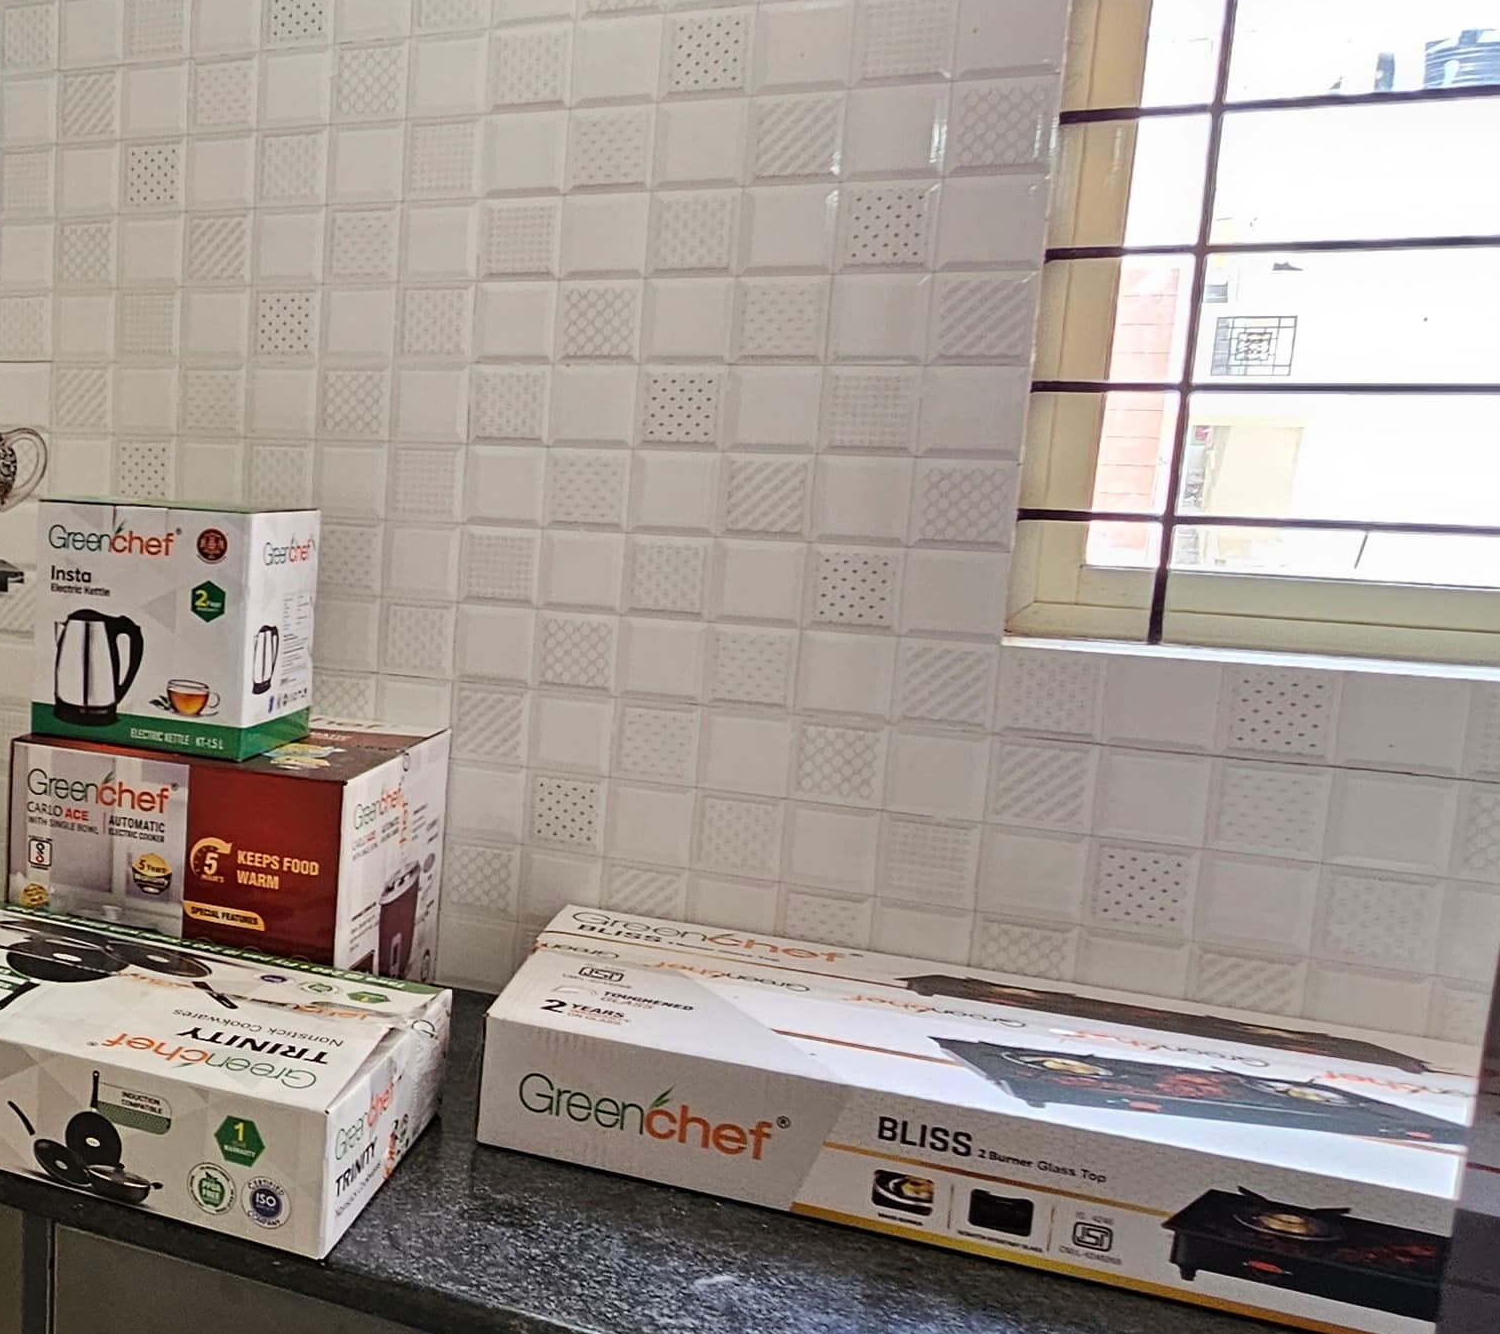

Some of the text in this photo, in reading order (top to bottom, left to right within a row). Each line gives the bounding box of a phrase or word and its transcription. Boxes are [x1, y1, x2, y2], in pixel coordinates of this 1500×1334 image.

[48, 523, 175, 557] Greenchef
[51, 565, 92, 584] Insta
[50, 583, 111, 597] Electric Kettle
[195, 589, 209, 607] 2
[130, 727, 163, 743] ELECTRIC
[164, 731, 191, 746] KETTLE
[27, 768, 170, 814] Greenchef
[64, 808, 89, 821] ACE
[109, 815, 165, 833] AUTOMATIC
[50, 820, 76, 832] SINGLE
[108, 827, 165, 844] ELECTRIC COOKER
[138, 859, 146, 871] 5
[204, 852, 219, 875] 5
[237, 849, 319, 876] KEEPS FOOD
[237, 870, 279, 890] WARM
[191, 906, 258, 926] SPECIAL FEATURES
[572, 911, 846, 964] Greenchef
[578, 923, 663, 944] BLISS
[540, 999, 567, 1014] 2
[571, 1002, 625, 1019] YEARS
[603, 990, 695, 1011] TOUGHENED
[172, 1008, 344, 1048] Nonstick Cookwares
[176, 1026, 329, 1065] TRINITY
[101, 1033, 318, 1090] Greenchef
[121, 1090, 161, 1106] INDUCTION
[121, 1098, 163, 1115] COMPATIBLE
[519, 1073, 772, 1160] Greenchef
[234, 1121, 245, 1142] 1
[877, 1116, 1108, 1184] BLISS 2 Burner Glass Top
[255, 1193, 277, 1208] ISO
